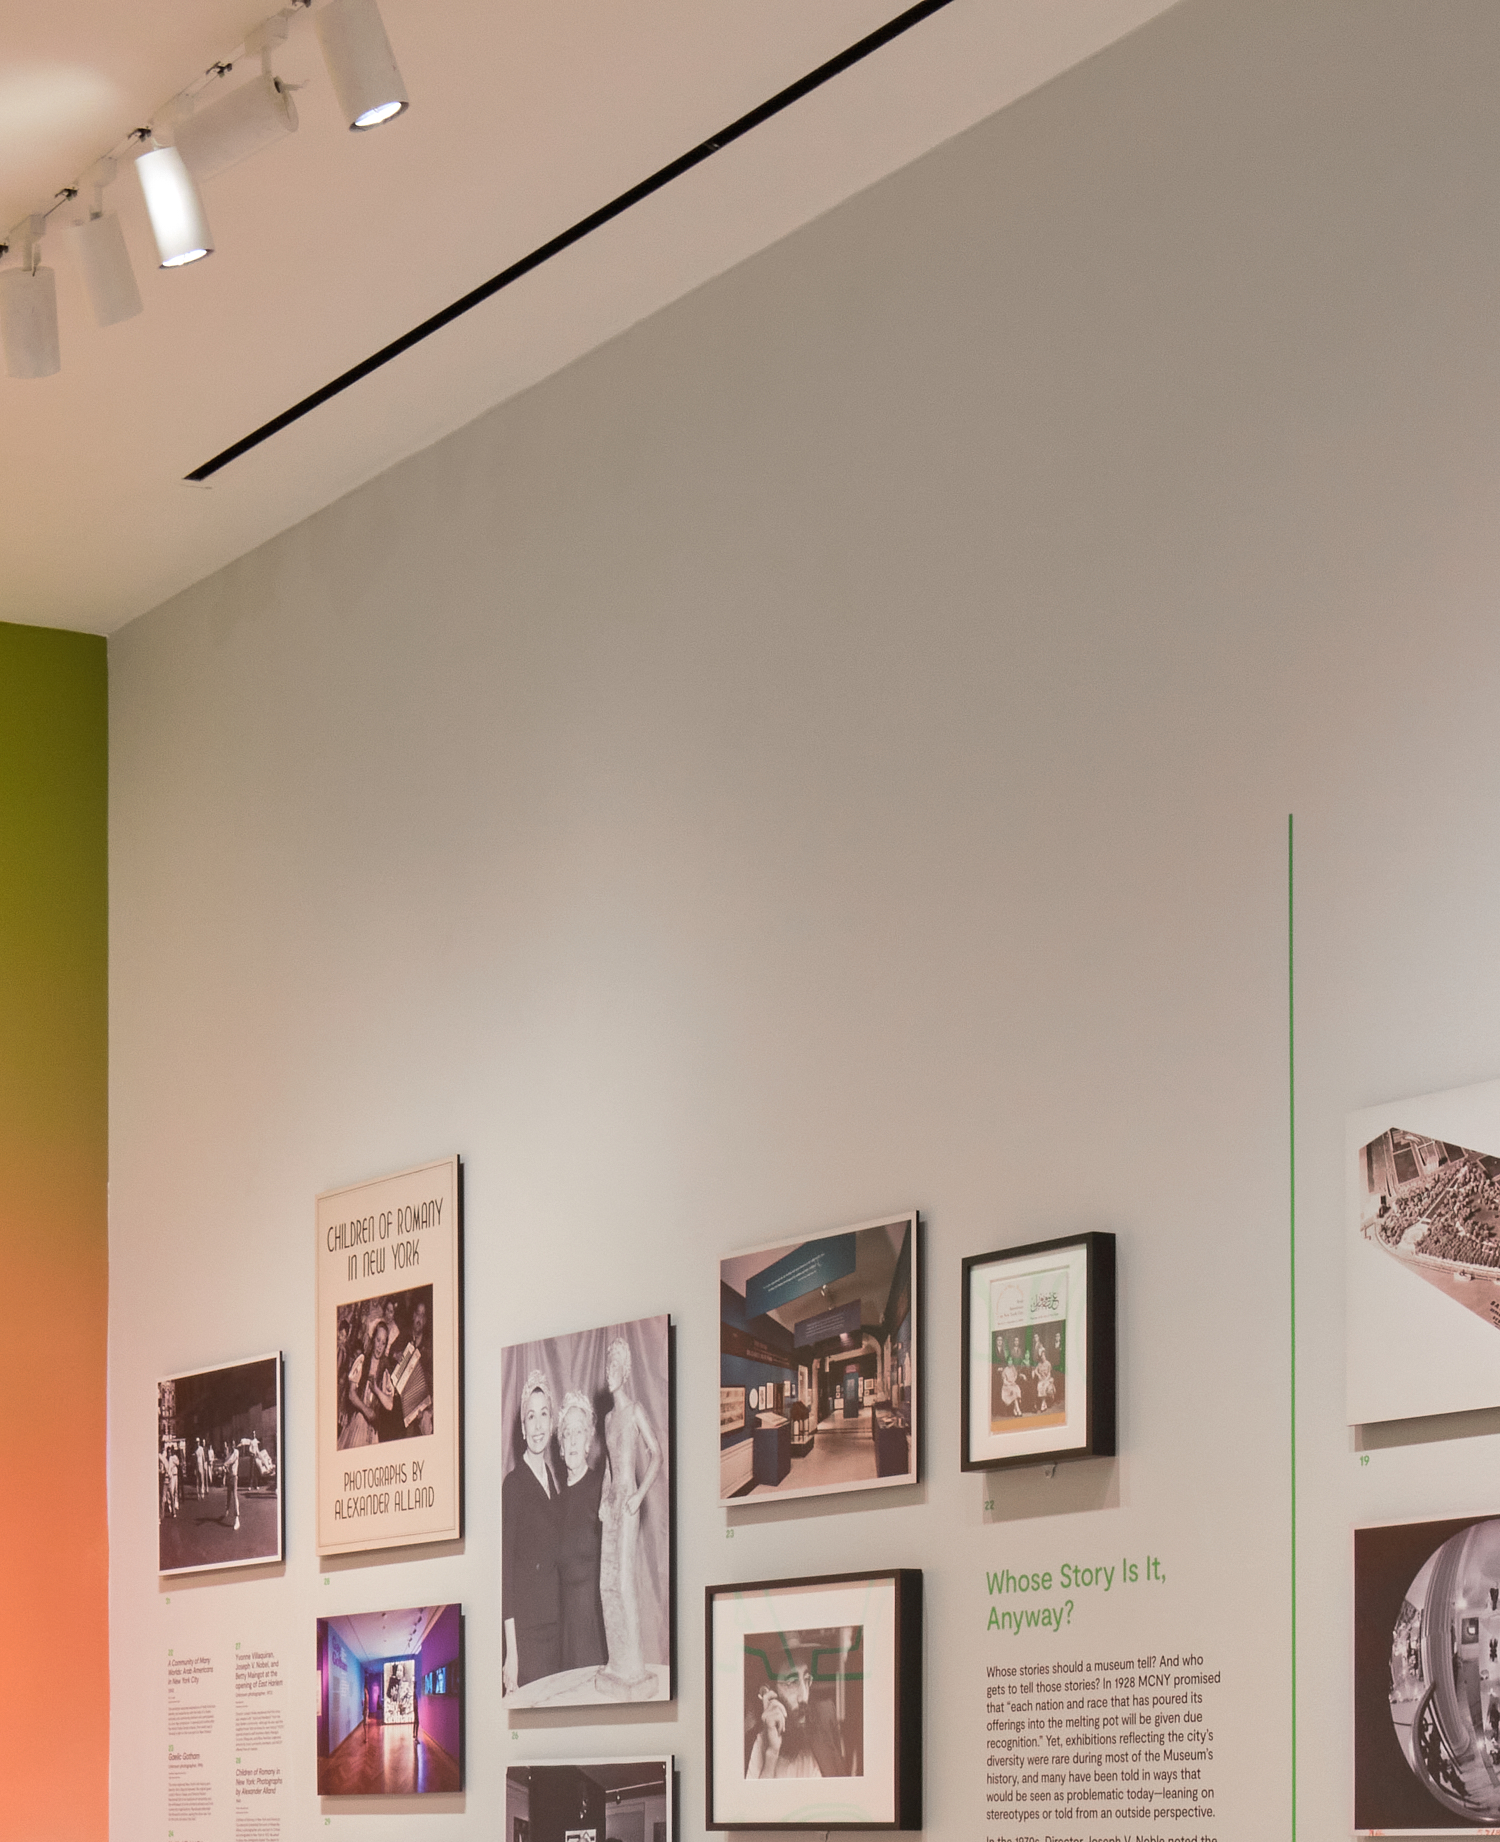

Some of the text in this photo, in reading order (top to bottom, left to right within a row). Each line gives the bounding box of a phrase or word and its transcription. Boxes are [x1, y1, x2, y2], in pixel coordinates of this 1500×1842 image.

[328, 1198, 443, 1252] CHILDREN OF ROMANY
[348, 1239, 419, 1281] IN NEW YORK
[1360, 1456, 1370, 1465] 19
[344, 1461, 424, 1491] PHOTOGRAPHS BY
[335, 1486, 434, 1520] ALEXANDER ALLAND
[985, 1500, 994, 1511] 22
[726, 1529, 734, 1538] 23
[985, 1556, 1166, 1596] Whose Story Is It,
[986, 1599, 1075, 1636] Anyway?
[987, 1653, 1204, 1677] Whose stories should a museum tell? And who
[987, 1670, 1221, 1698] gets to tell those stories? In 1928 MCNY promised
